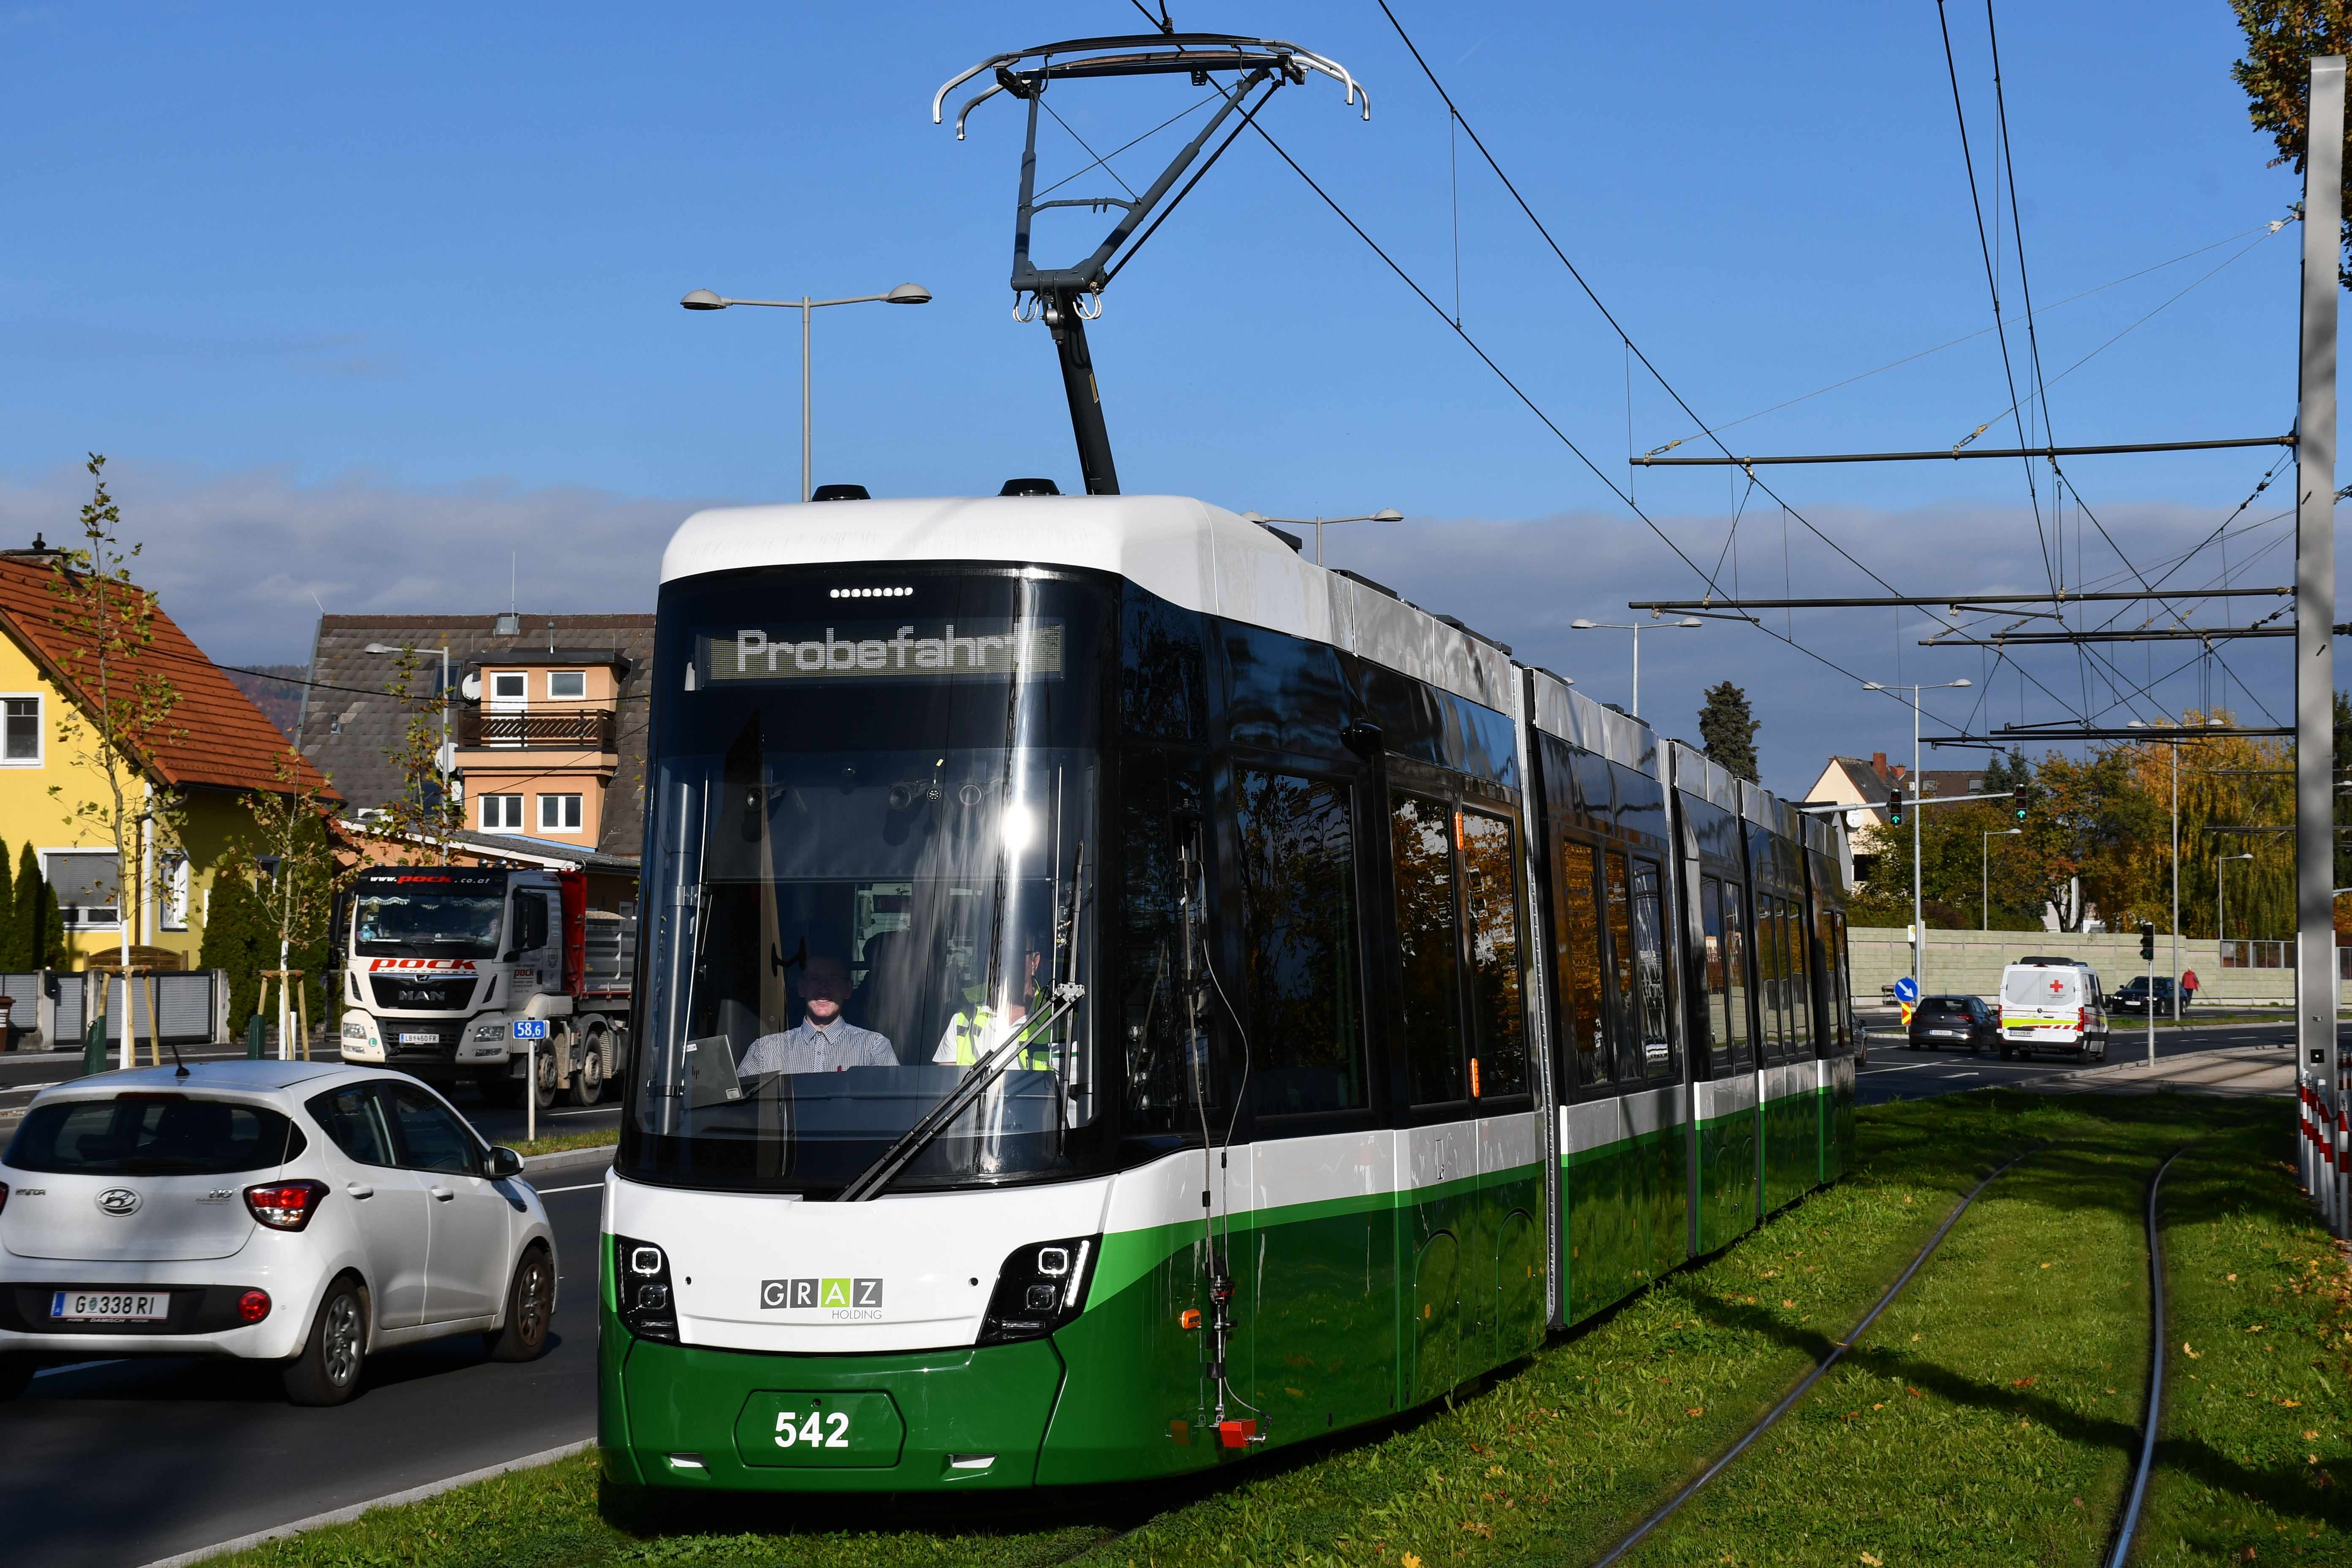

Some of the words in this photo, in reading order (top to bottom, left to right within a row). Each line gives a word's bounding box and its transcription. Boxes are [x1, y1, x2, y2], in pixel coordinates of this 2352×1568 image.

[738, 622, 1033, 672] Probefahrt
[398, 991, 445, 1001] MAN
[517, 1022, 541, 1037] 58,6
[764, 1282, 877, 1306] GRAZ
[99, 1296, 133, 1314] 338
[832, 1310, 882, 1319] HOLDING
[775, 1412, 849, 1448] 542
